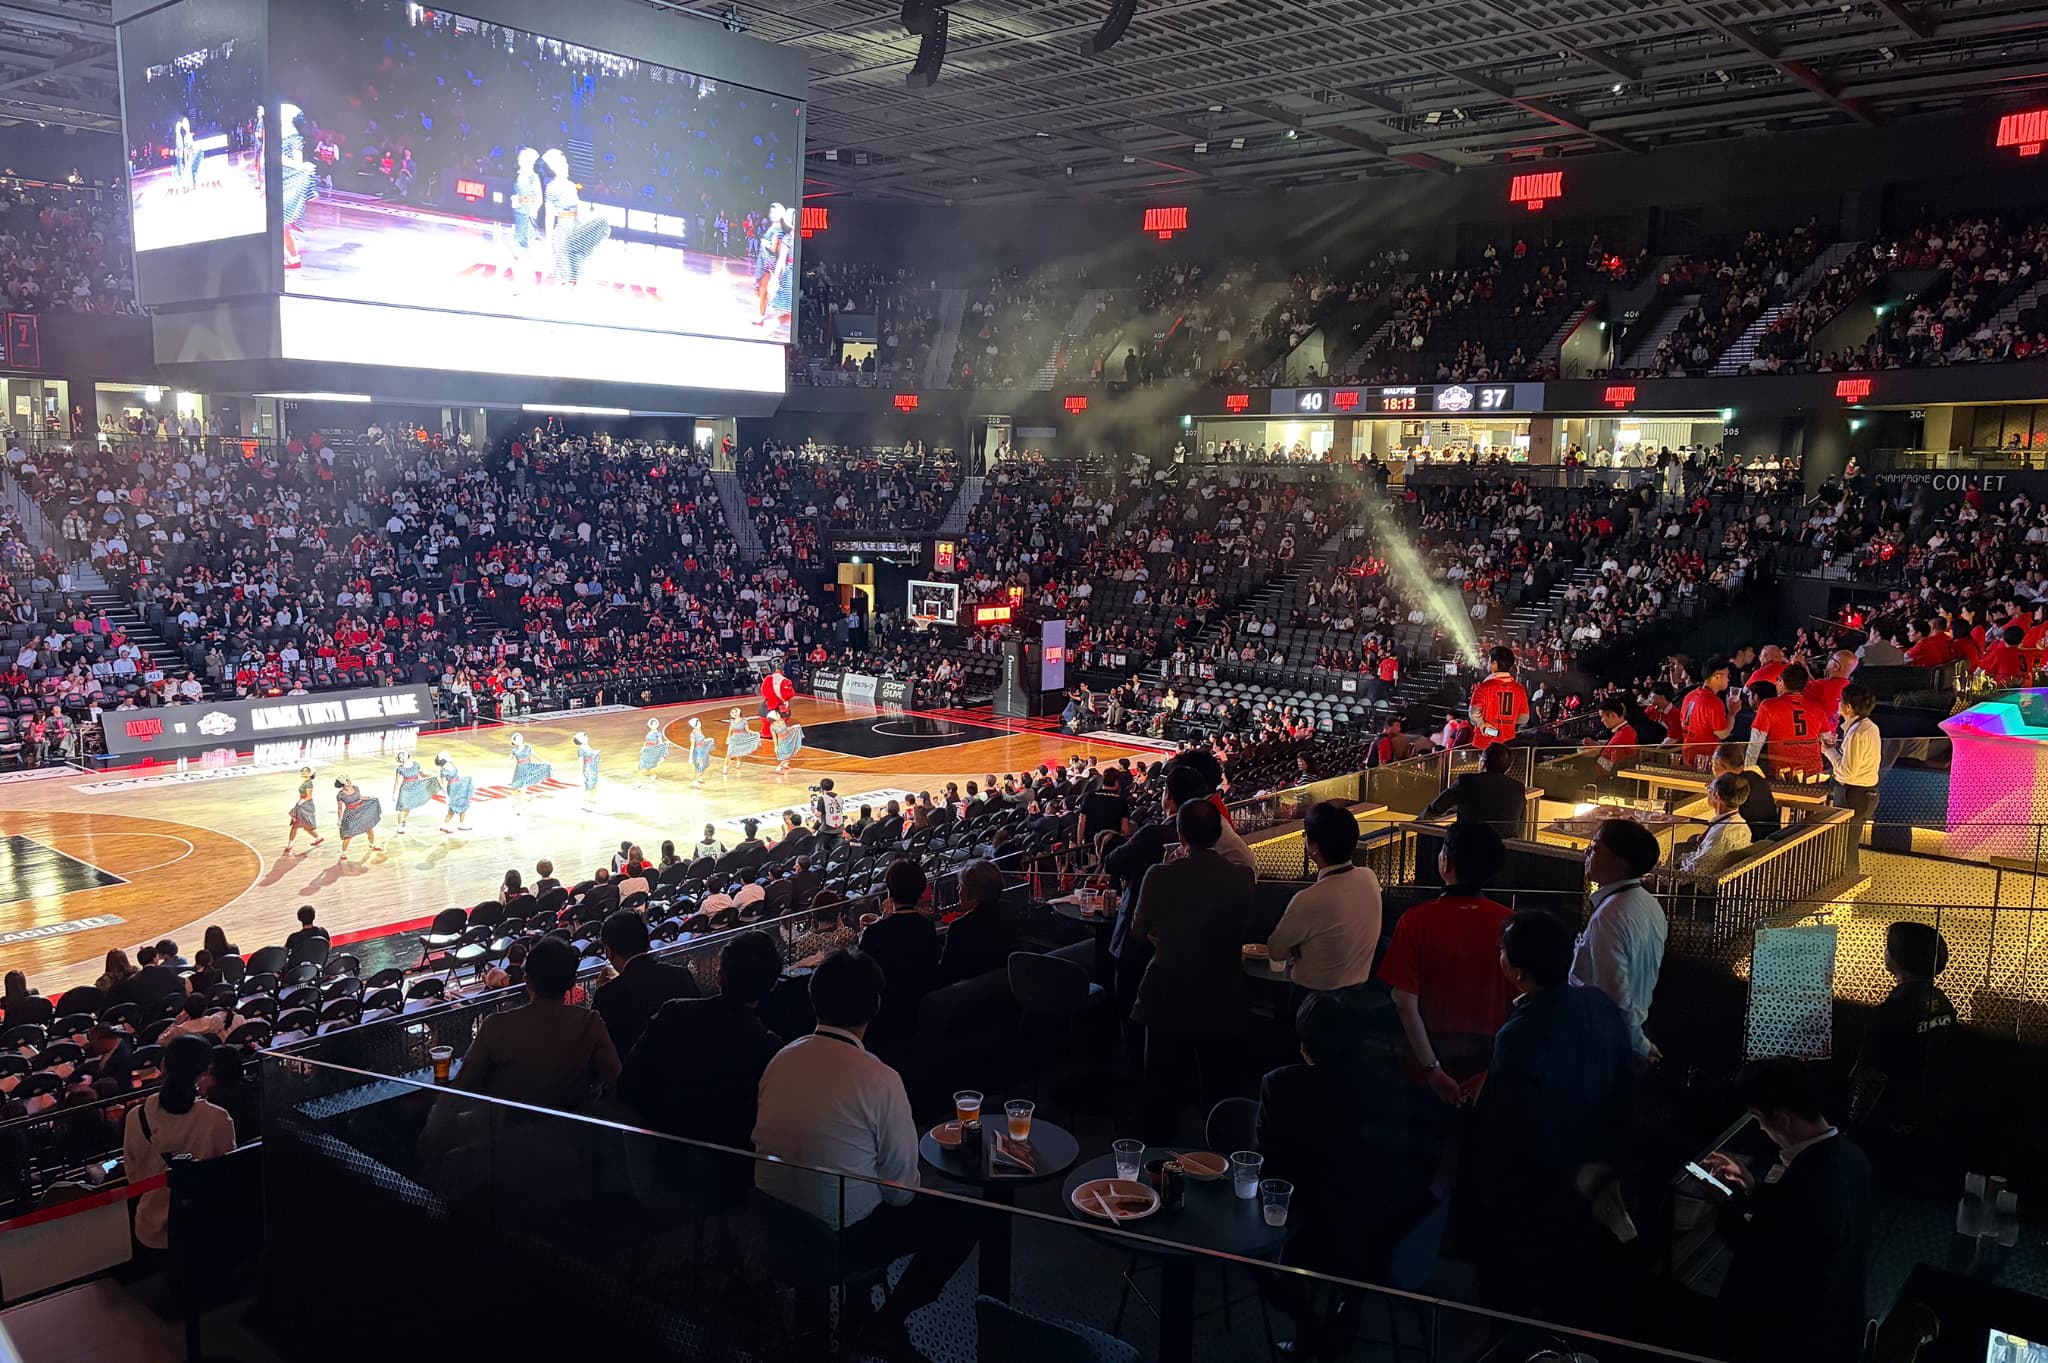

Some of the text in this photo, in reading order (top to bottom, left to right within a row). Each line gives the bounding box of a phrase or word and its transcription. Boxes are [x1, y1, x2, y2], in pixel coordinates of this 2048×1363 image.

[1996, 110, 2048, 147] ALVAR
[1509, 171, 1563, 202] ALVARK
[801, 207, 828, 229] ARK
[1143, 207, 1188, 230] ALVARK
[1604, 386, 1636, 402] ALVARK
[1835, 379, 1871, 397] ALVARK
[1300, 392, 1323, 411] 40
[1383, 397, 1416, 411] 18:13
[1482, 389, 1507, 408] 37
[1723, 427, 1739, 436] 305
[938, 553, 952, 566] 24
[1496, 691, 1514, 716] 10
[126, 718, 164, 737] ALVARK
[1792, 709, 1807, 737] 5
[80, 770, 202, 789] TOYOTA
[0, 921, 76, 943] AGUE
